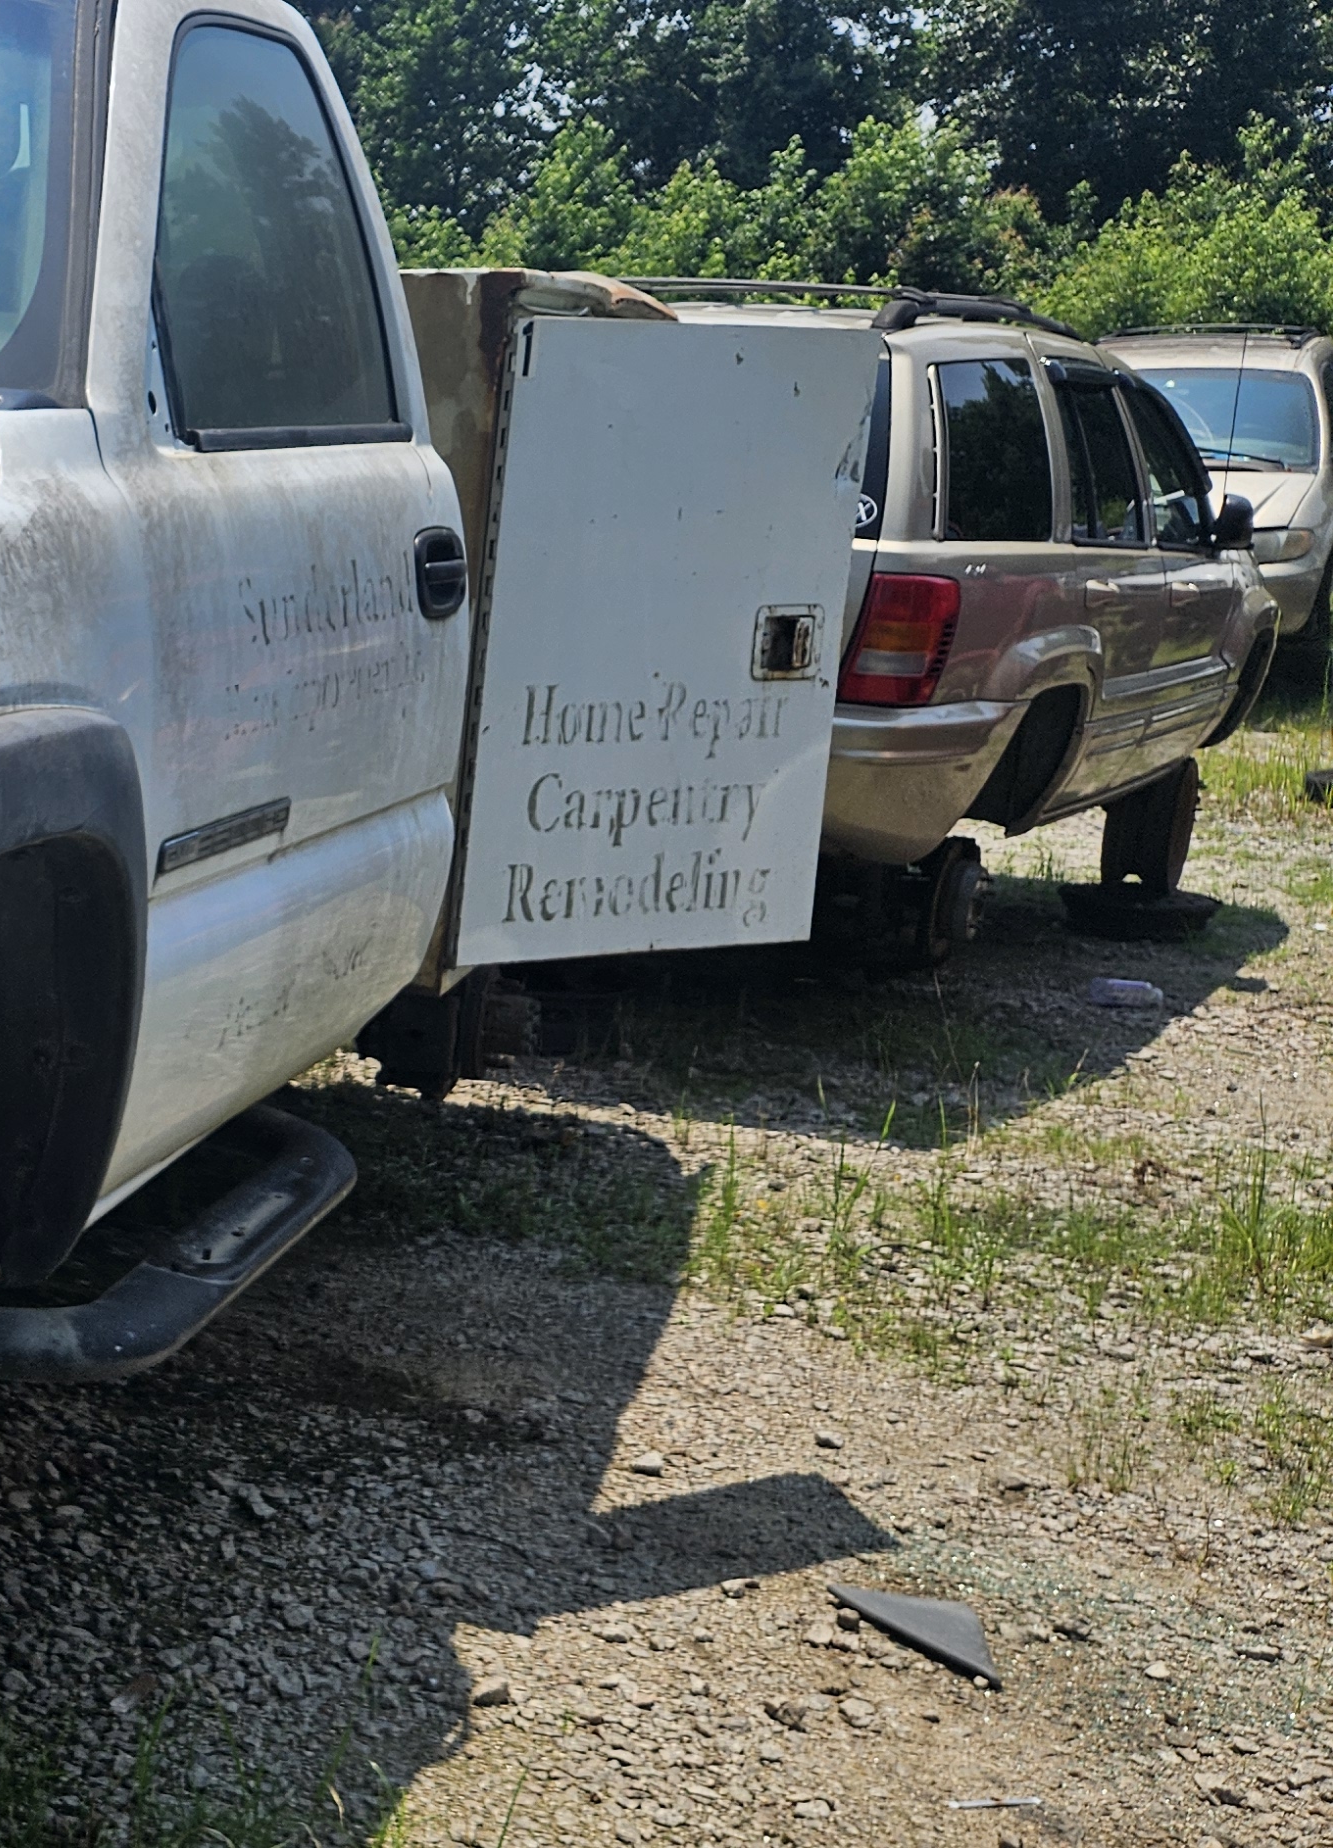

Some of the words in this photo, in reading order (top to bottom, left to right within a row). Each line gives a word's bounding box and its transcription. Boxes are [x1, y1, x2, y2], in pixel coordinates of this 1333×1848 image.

[521, 684, 646, 745] Home
[657, 680, 790, 759] Repair
[527, 772, 765, 848] Carpentry
[501, 848, 771, 928] Remodeling
